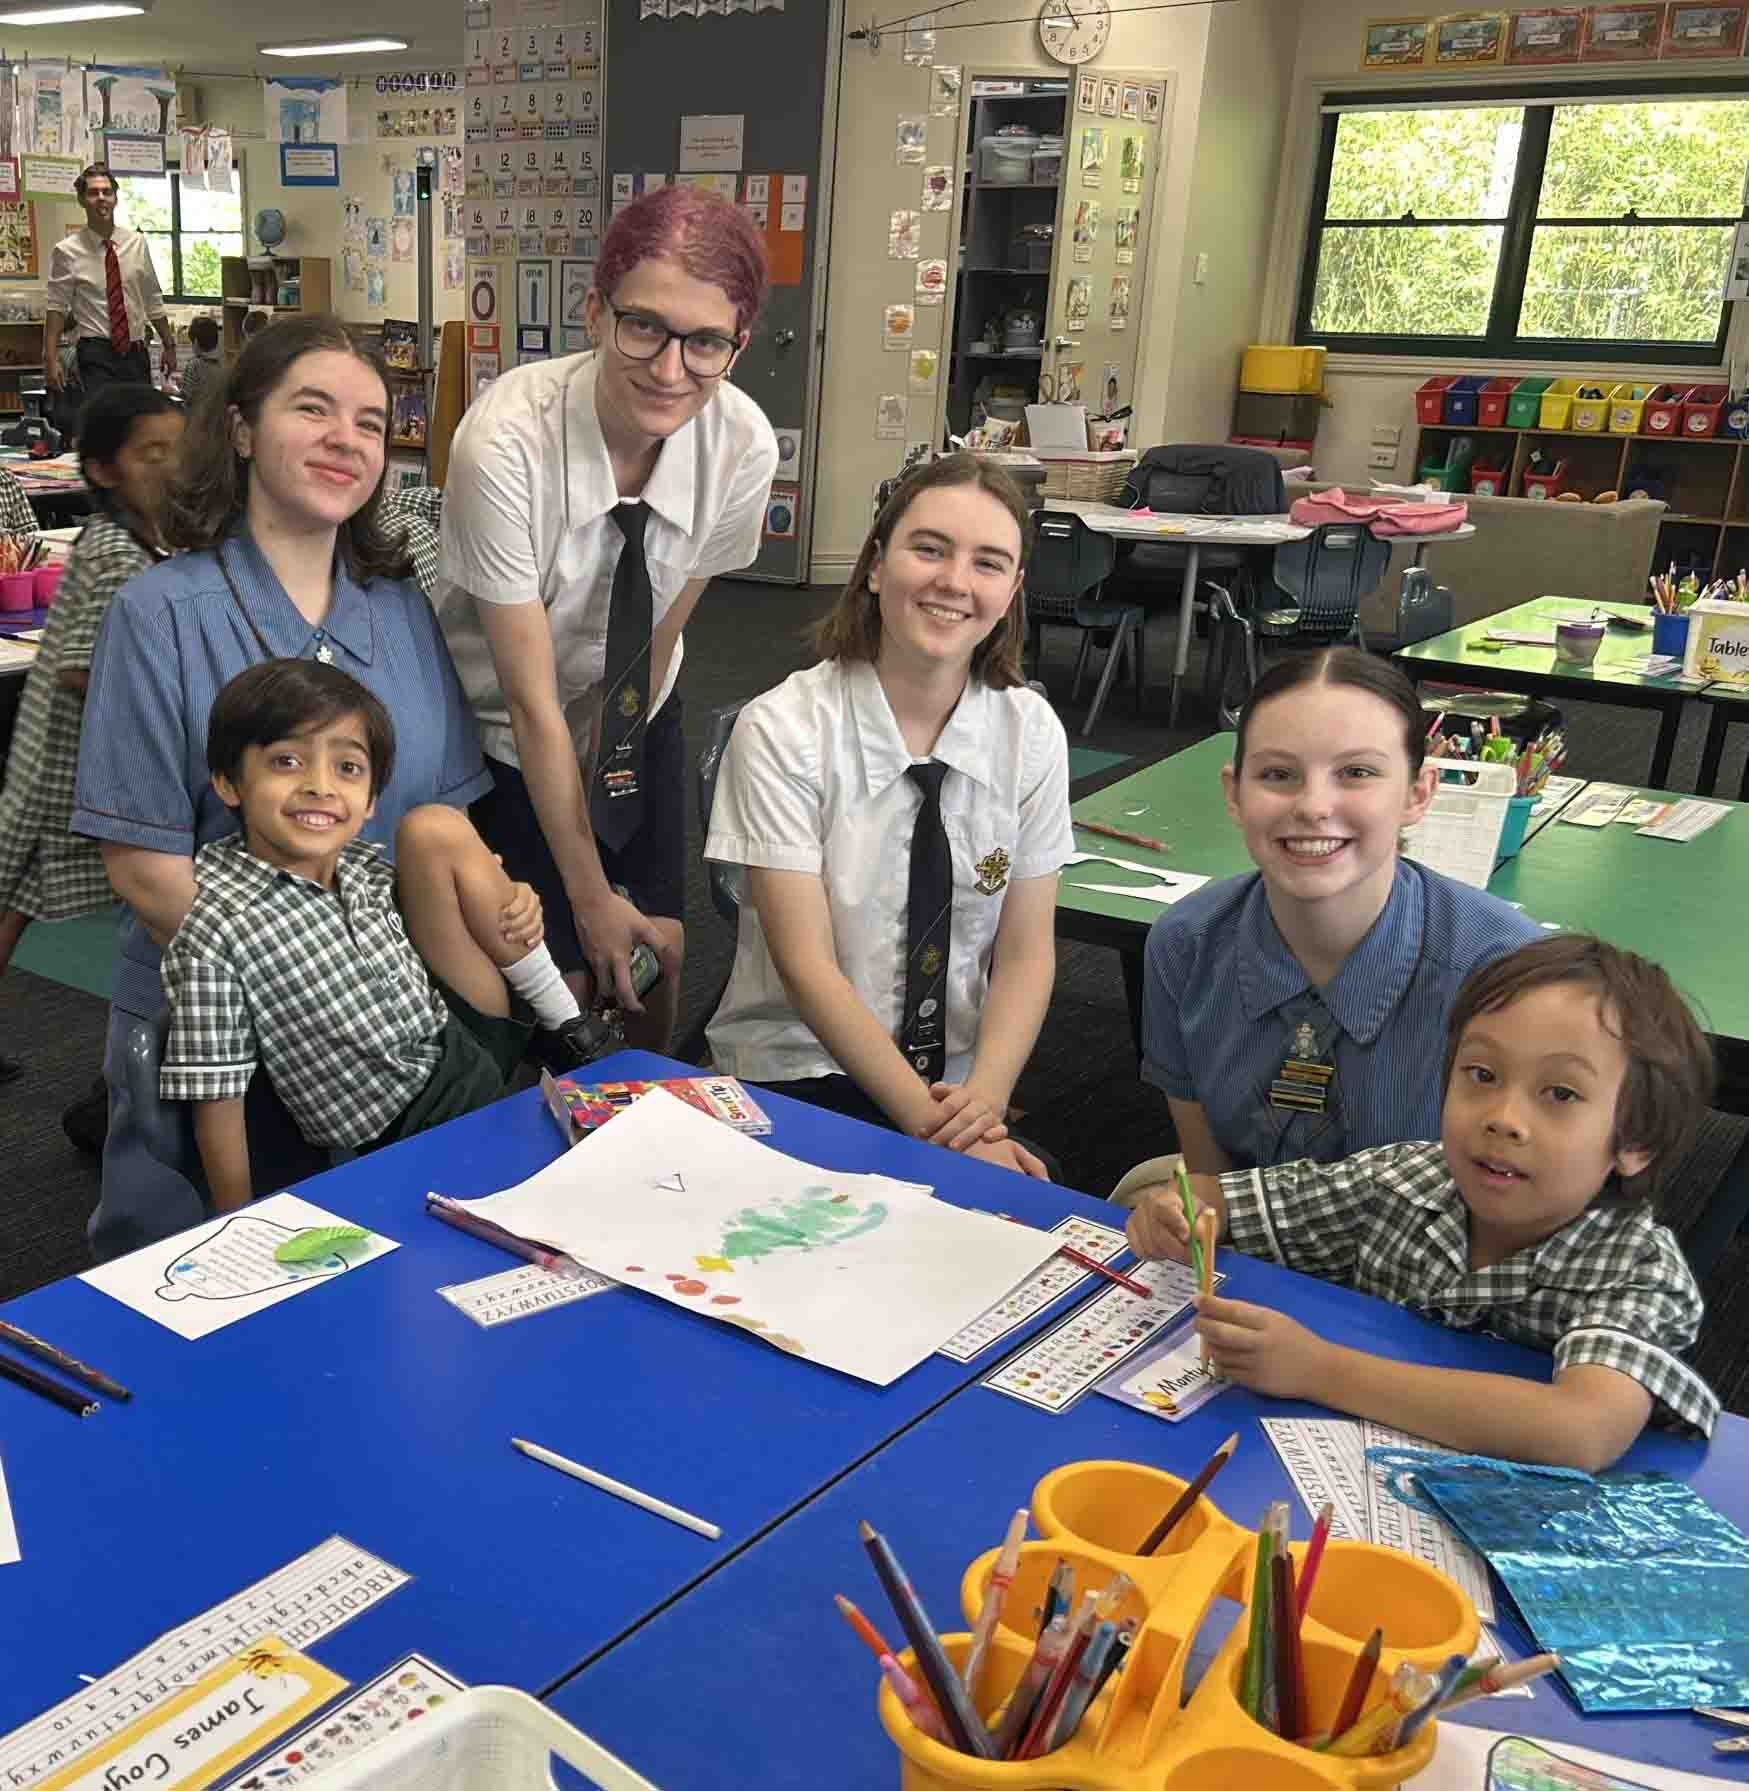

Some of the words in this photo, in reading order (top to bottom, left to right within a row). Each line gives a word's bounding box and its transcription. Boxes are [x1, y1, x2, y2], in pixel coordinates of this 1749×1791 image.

[1096, 19, 1104, 30] 3
[501, 37, 509, 51] 2
[528, 34, 536, 49] 3
[555, 33, 563, 48] 4
[584, 31, 592, 46] 5
[1049, 32, 1057, 41] 8
[1069, 47, 1077, 57] 6
[473, 97, 481, 111] 6
[502, 95, 509, 109] 7
[528, 93, 536, 107] 8
[556, 92, 563, 106] 9
[582, 90, 592, 105] 10
[474, 153, 480, 167] 11
[500, 153, 510, 167] 12
[527, 152, 536, 166] 13
[554, 151, 564, 164] 14
[581, 151, 592, 165] 15
[473, 210, 482, 224] 16
[500, 208, 510, 223] 17
[526, 209, 536, 223] 18
[553, 209, 563, 223] 19
[579, 209, 592, 223] 20
[1706, 637, 1748, 657] Table
[173, 1687, 265, 1751] James
[102, 1752, 171, 1791] Coy
